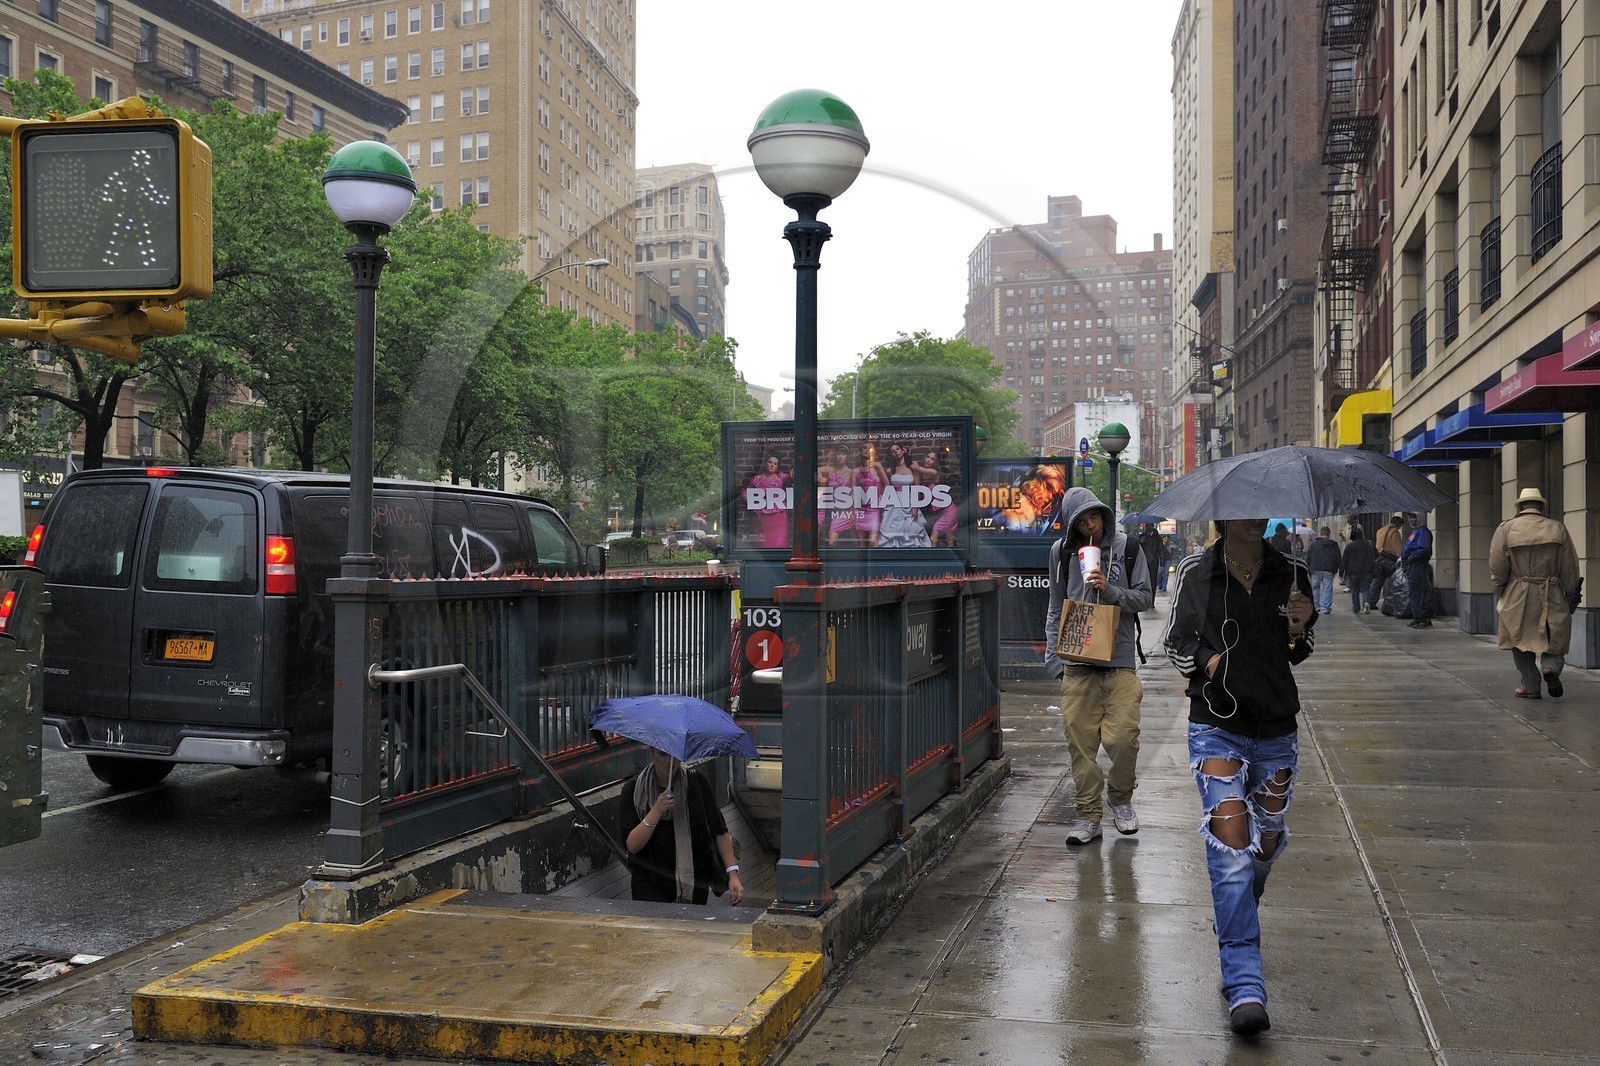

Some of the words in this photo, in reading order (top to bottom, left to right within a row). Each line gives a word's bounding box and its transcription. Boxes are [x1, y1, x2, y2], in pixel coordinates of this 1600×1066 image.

[746, 484, 953, 511] BRIESMAIDS
[977, 487, 1022, 509] OIRE
[830, 510, 852, 521] MAY
[854, 510, 866, 520] 13
[984, 518, 993, 527] 17
[1007, 575, 1050, 588] Statio
[743, 608, 781, 627] 103
[1066, 613, 1088, 625] CAN
[1062, 622, 1094, 636] EAGLE
[906, 618, 928, 656] bway
[1060, 632, 1092, 646] SINCE
[757, 638, 769, 662] 1
[1058, 642, 1084, 655] 1977
[197, 679, 252, 689] CHEVROLET
